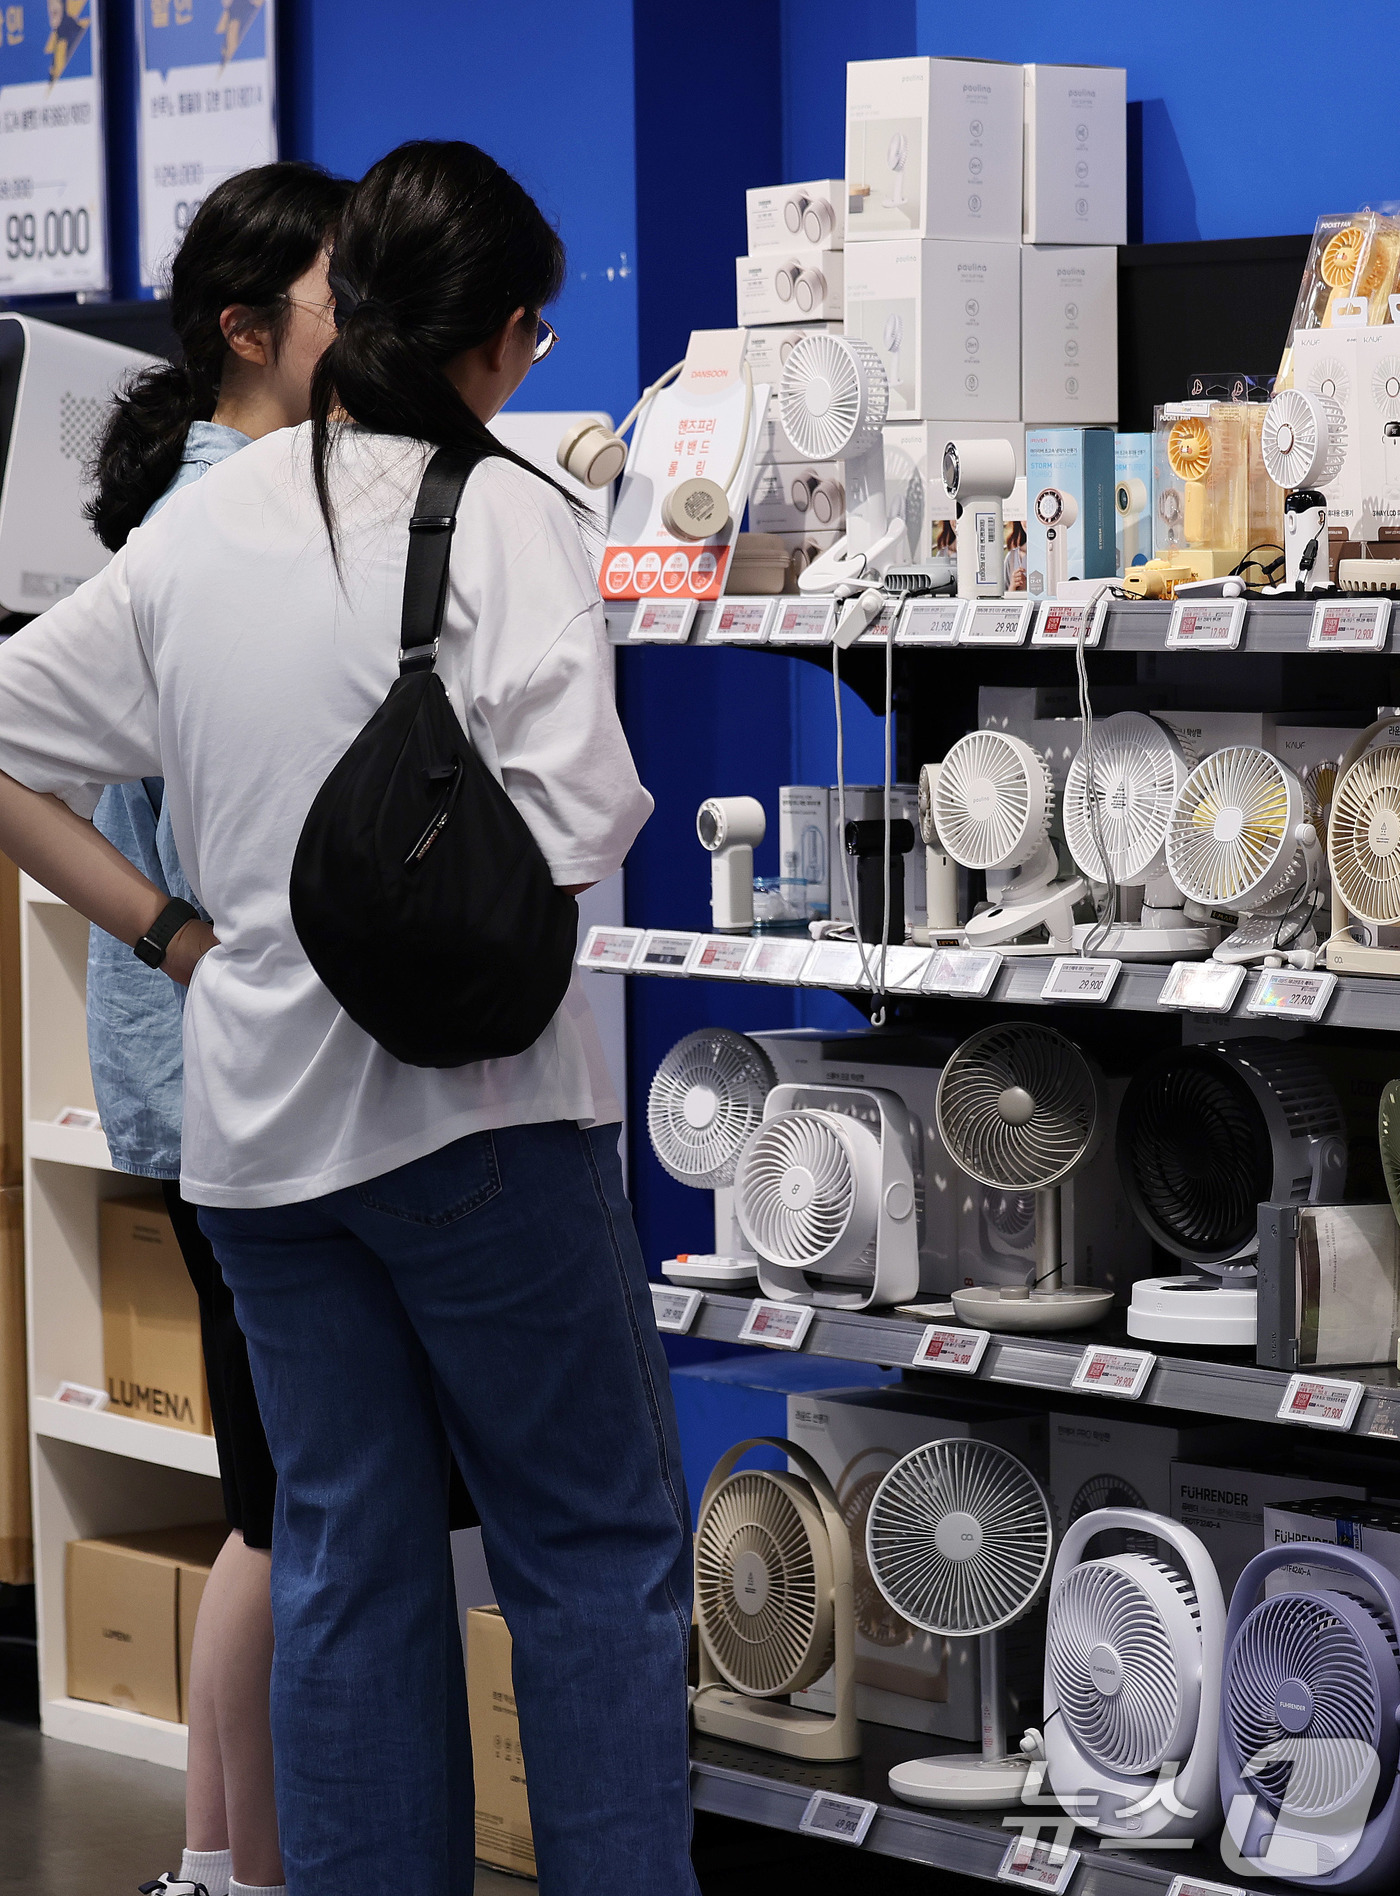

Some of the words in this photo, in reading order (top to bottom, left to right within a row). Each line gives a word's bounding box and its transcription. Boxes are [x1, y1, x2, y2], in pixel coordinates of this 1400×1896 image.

[962, 84, 991, 95] paulina
[1068, 88, 1096, 99] paulina
[6, 207, 90, 260] 99,000
[957, 263, 987, 274] paulina
[1056, 267, 1086, 278] paulina
[691, 370, 728, 378] DANSOON
[107, 1376, 194, 1424] LUMENA
[1181, 1485, 1248, 1506] FÜHRENDER
